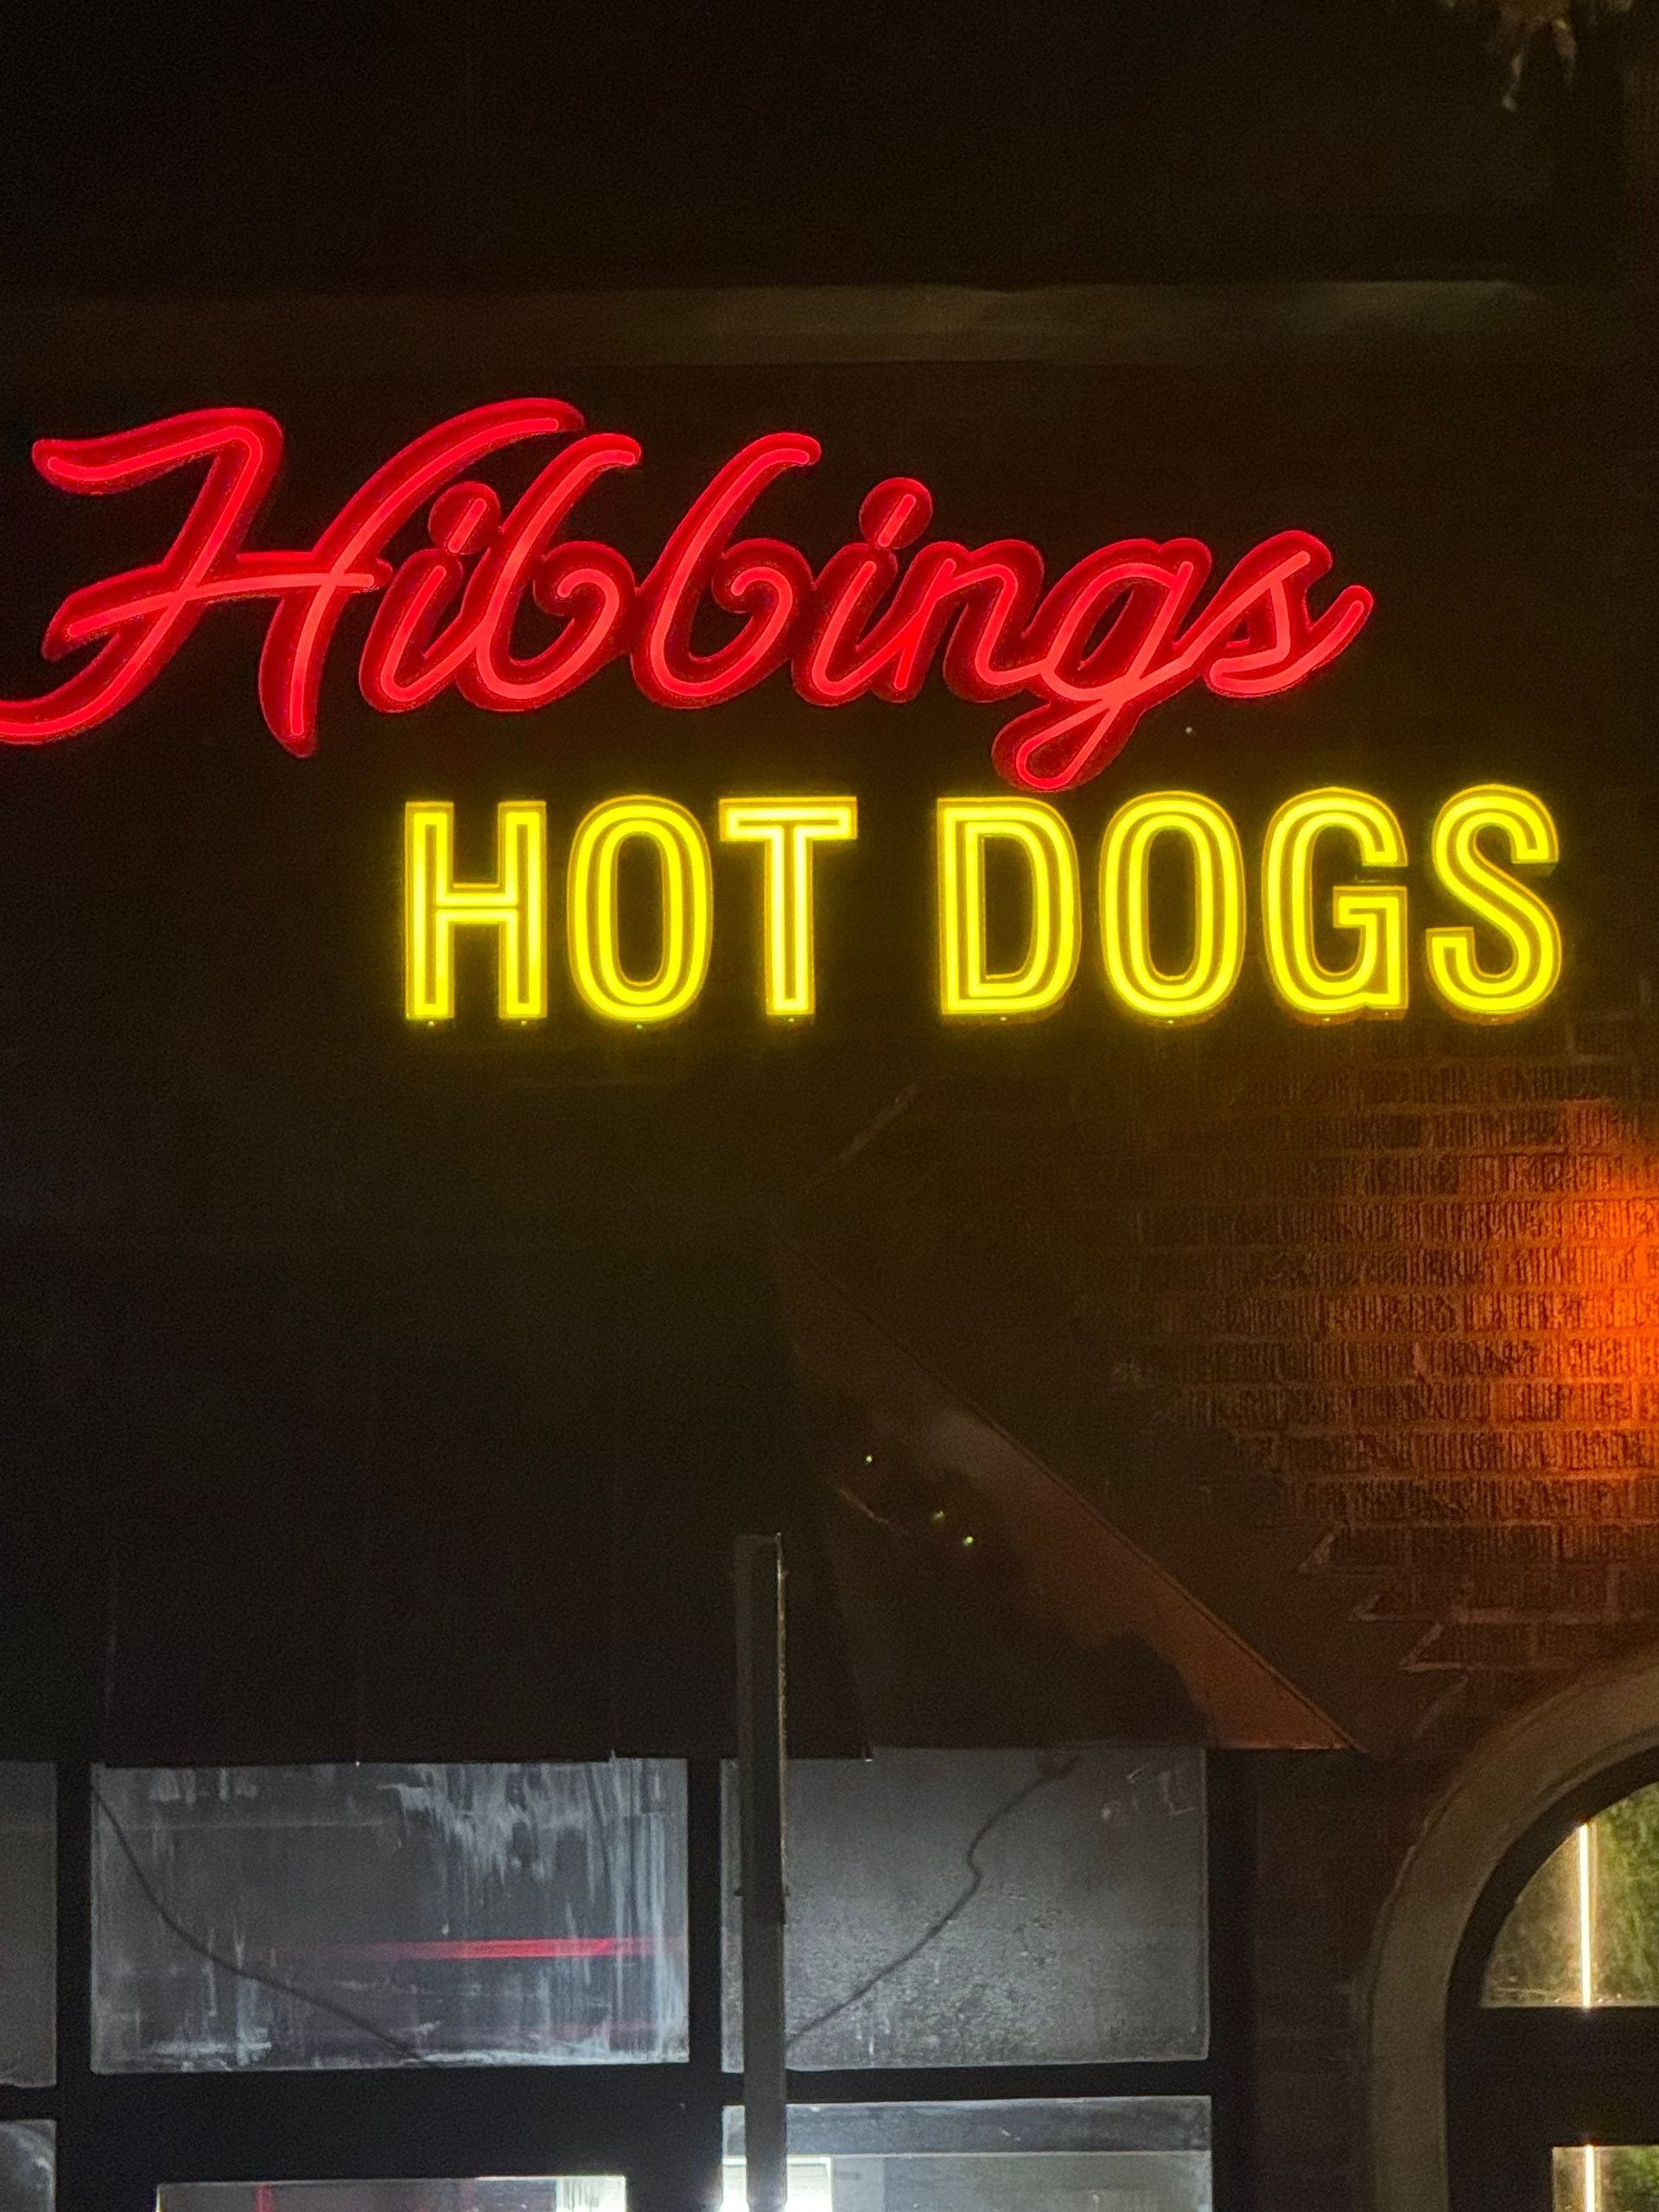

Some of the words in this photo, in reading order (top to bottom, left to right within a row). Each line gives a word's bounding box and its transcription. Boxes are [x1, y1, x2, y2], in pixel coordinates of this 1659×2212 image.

[0, 397, 1375, 791] Hibbings
[401, 794, 860, 1026] HOT
[936, 783, 1565, 1025] DOGS
